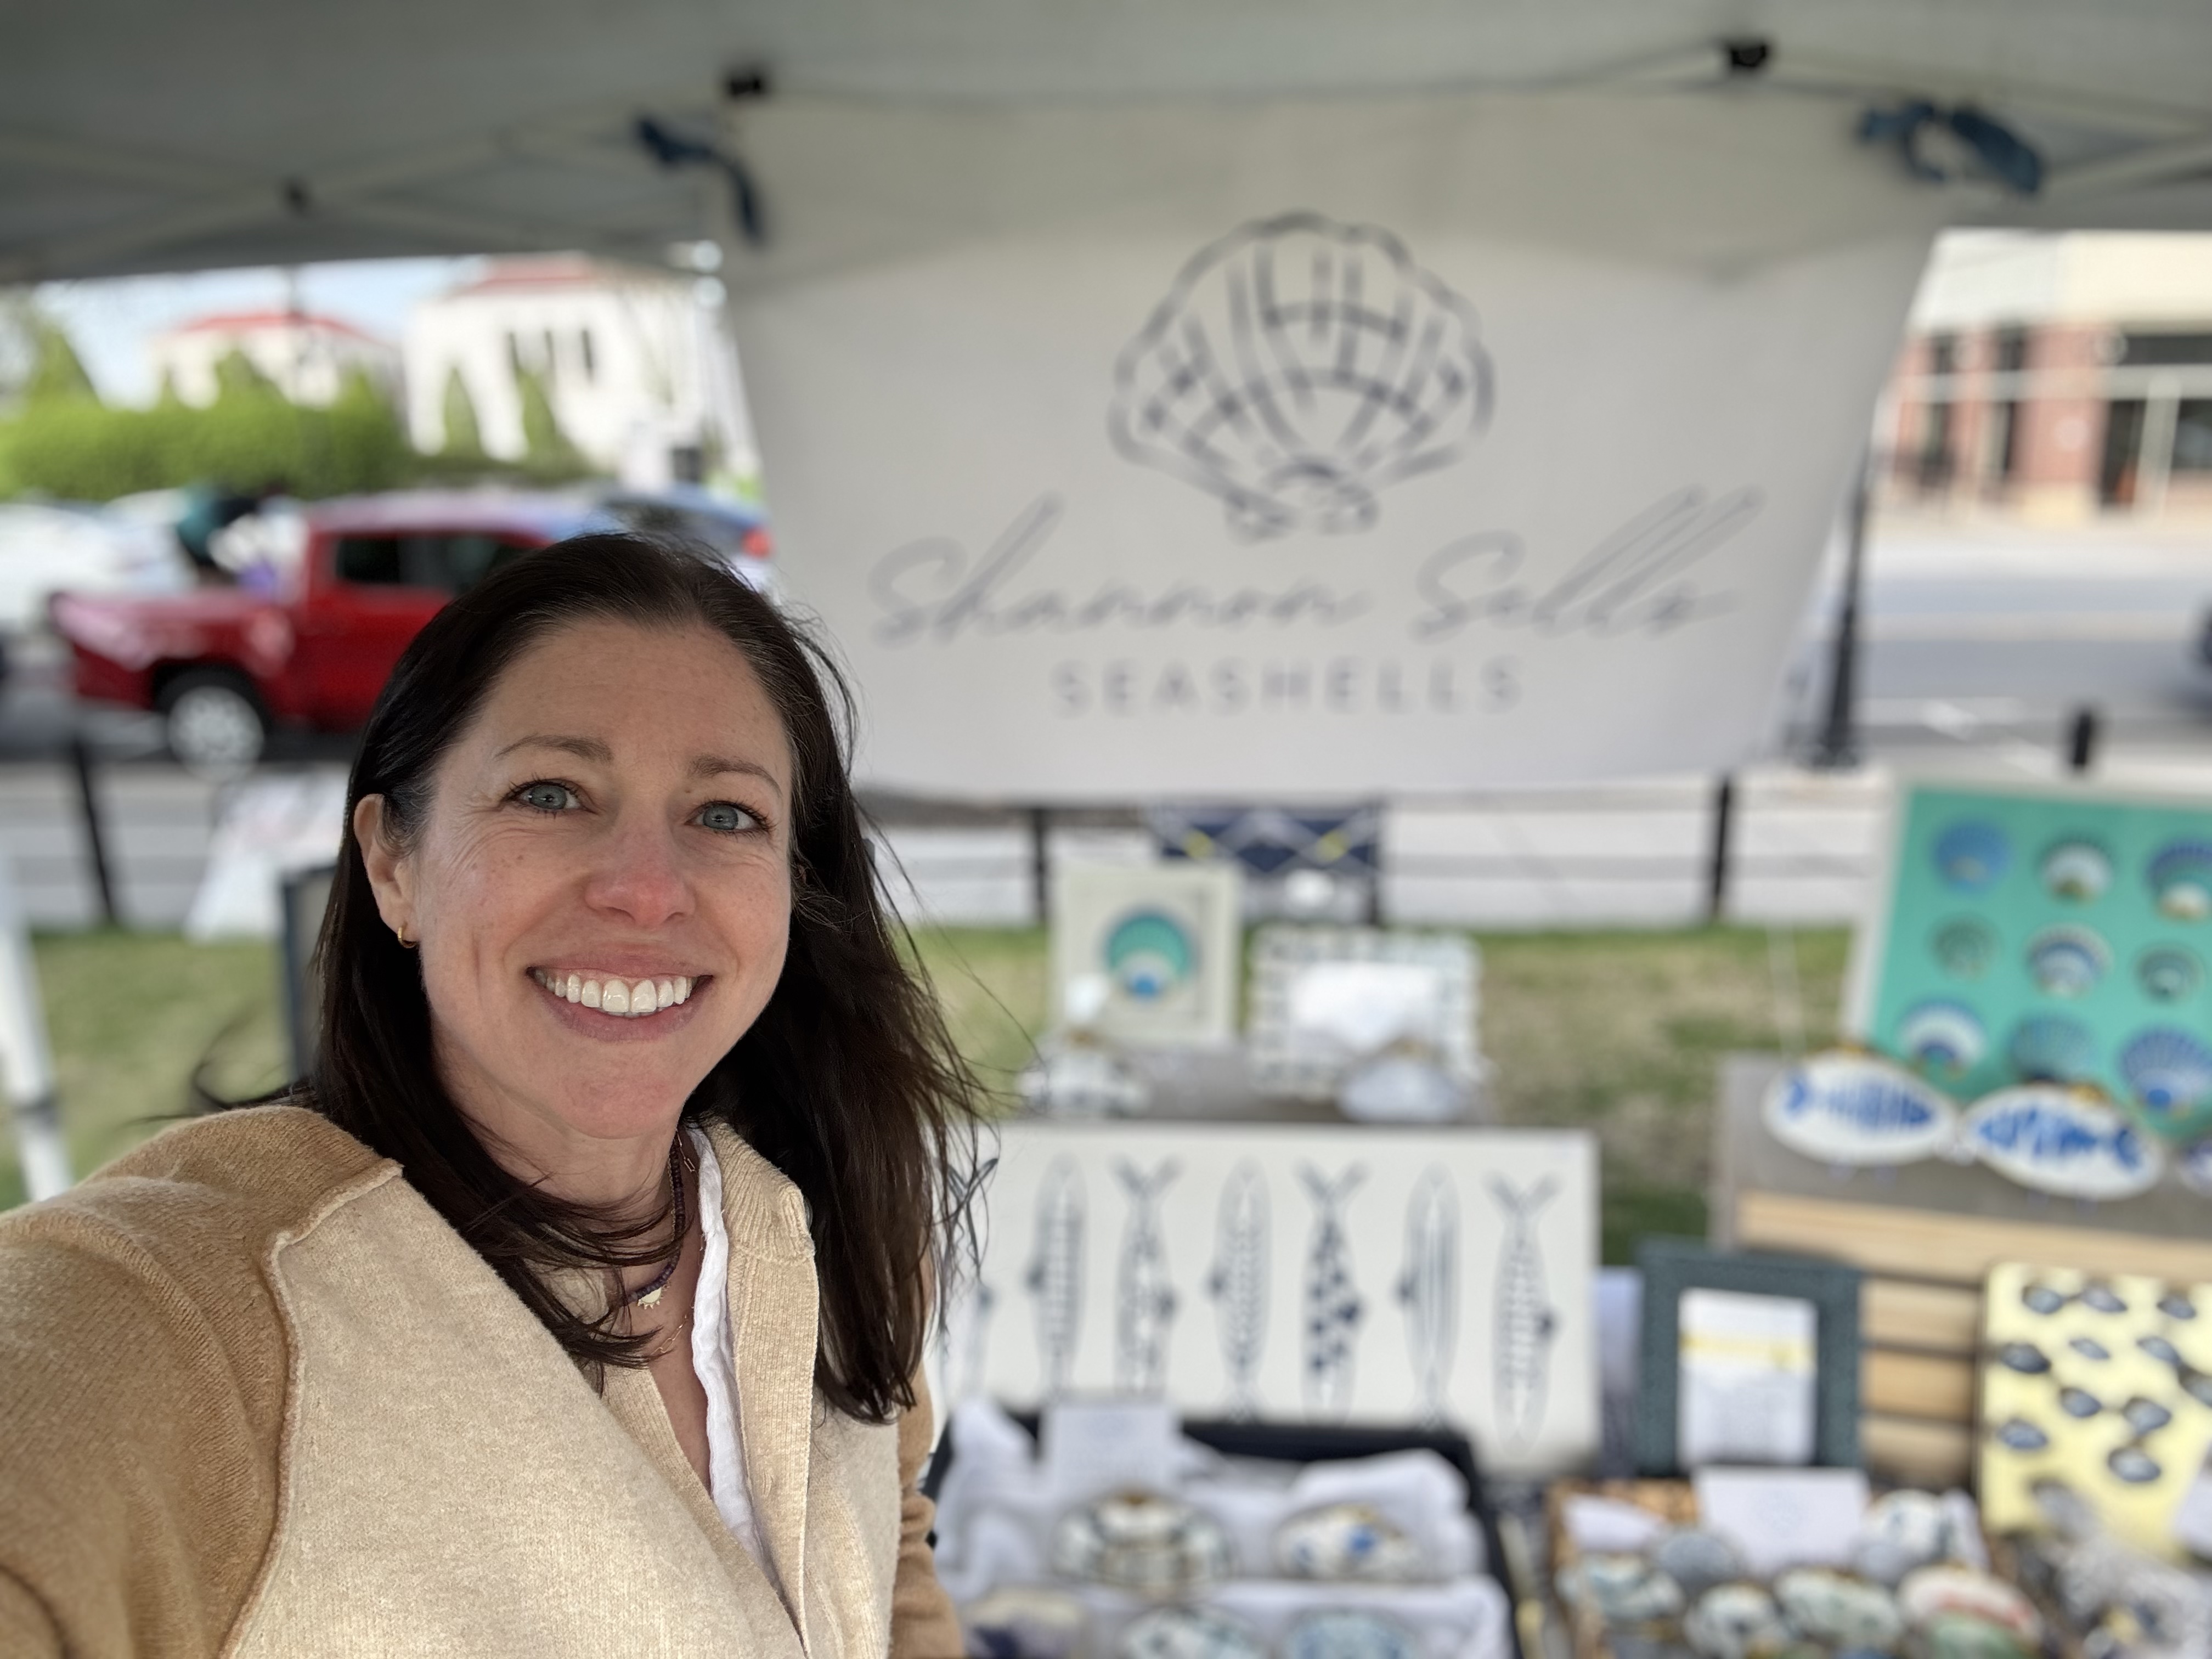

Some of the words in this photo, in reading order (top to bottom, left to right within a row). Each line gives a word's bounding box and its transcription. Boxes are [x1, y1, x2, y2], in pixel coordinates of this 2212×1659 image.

[868, 490, 1373, 650] Shannon
[1408, 484, 1765, 645] Sells
[1051, 654, 1523, 719] SEASHELLS
